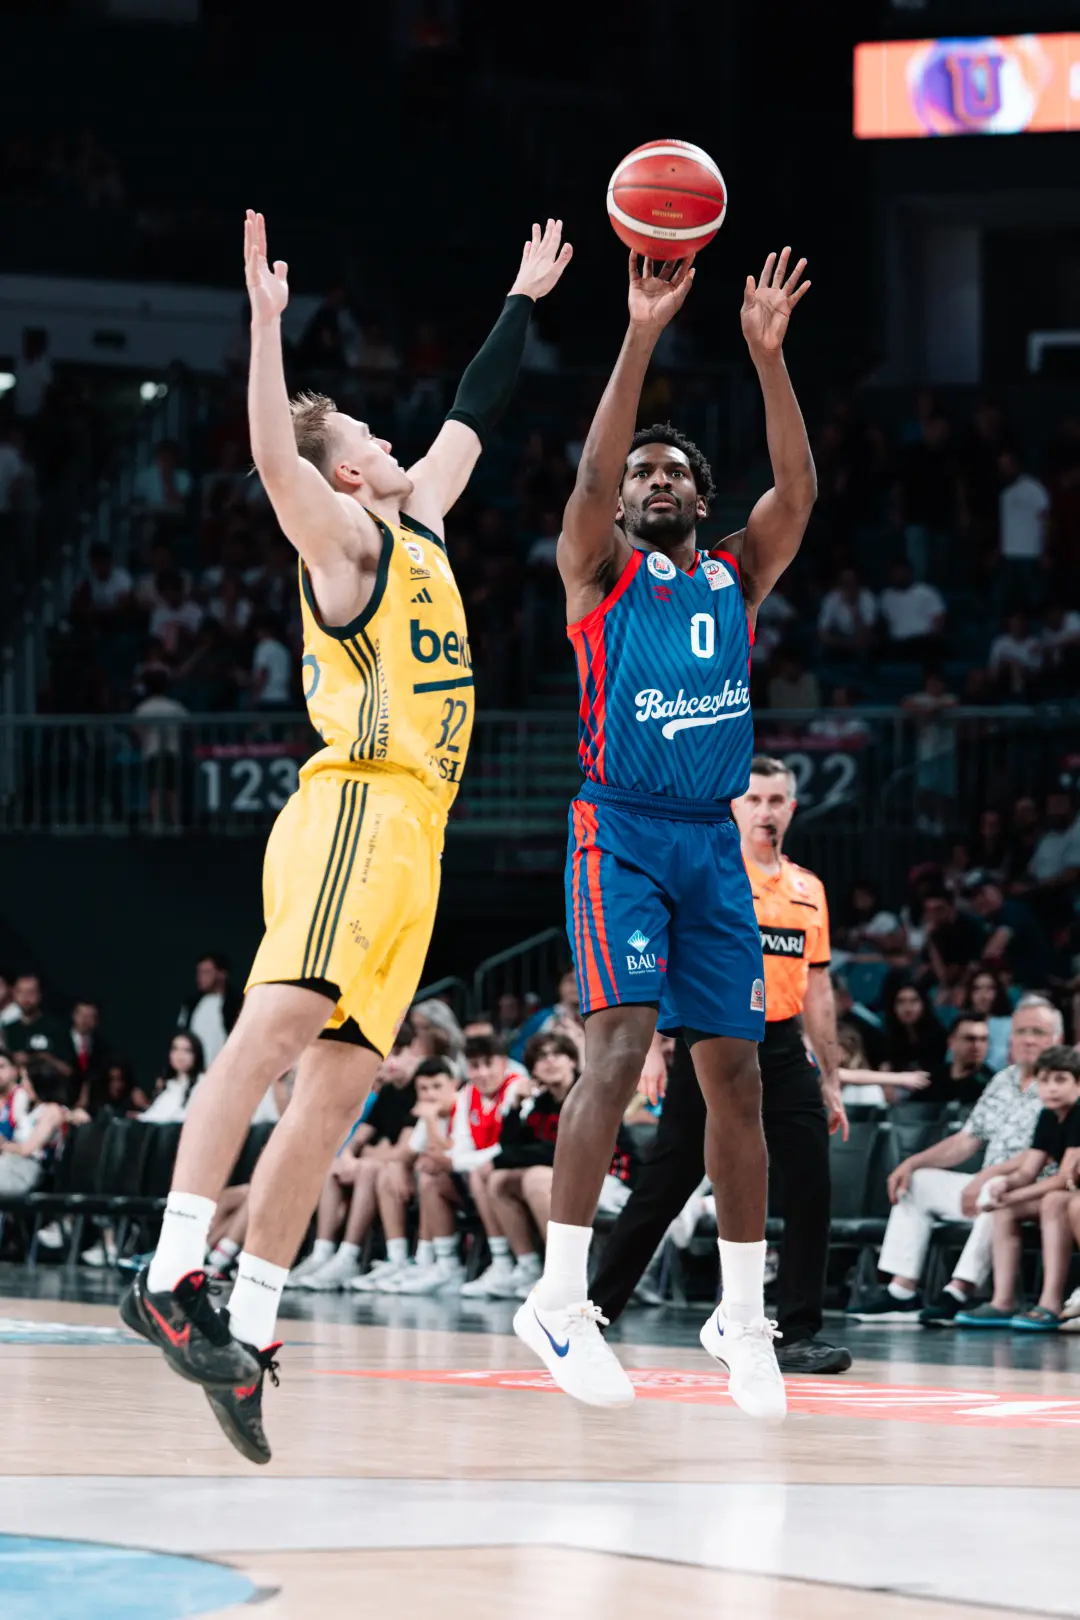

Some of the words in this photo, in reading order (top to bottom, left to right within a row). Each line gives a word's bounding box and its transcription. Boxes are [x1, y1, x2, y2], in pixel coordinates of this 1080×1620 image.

[690, 612, 715, 659] 0
[435, 697, 467, 753] 32
[200, 758, 300, 813] 123
[626, 953, 656, 971] BAU
